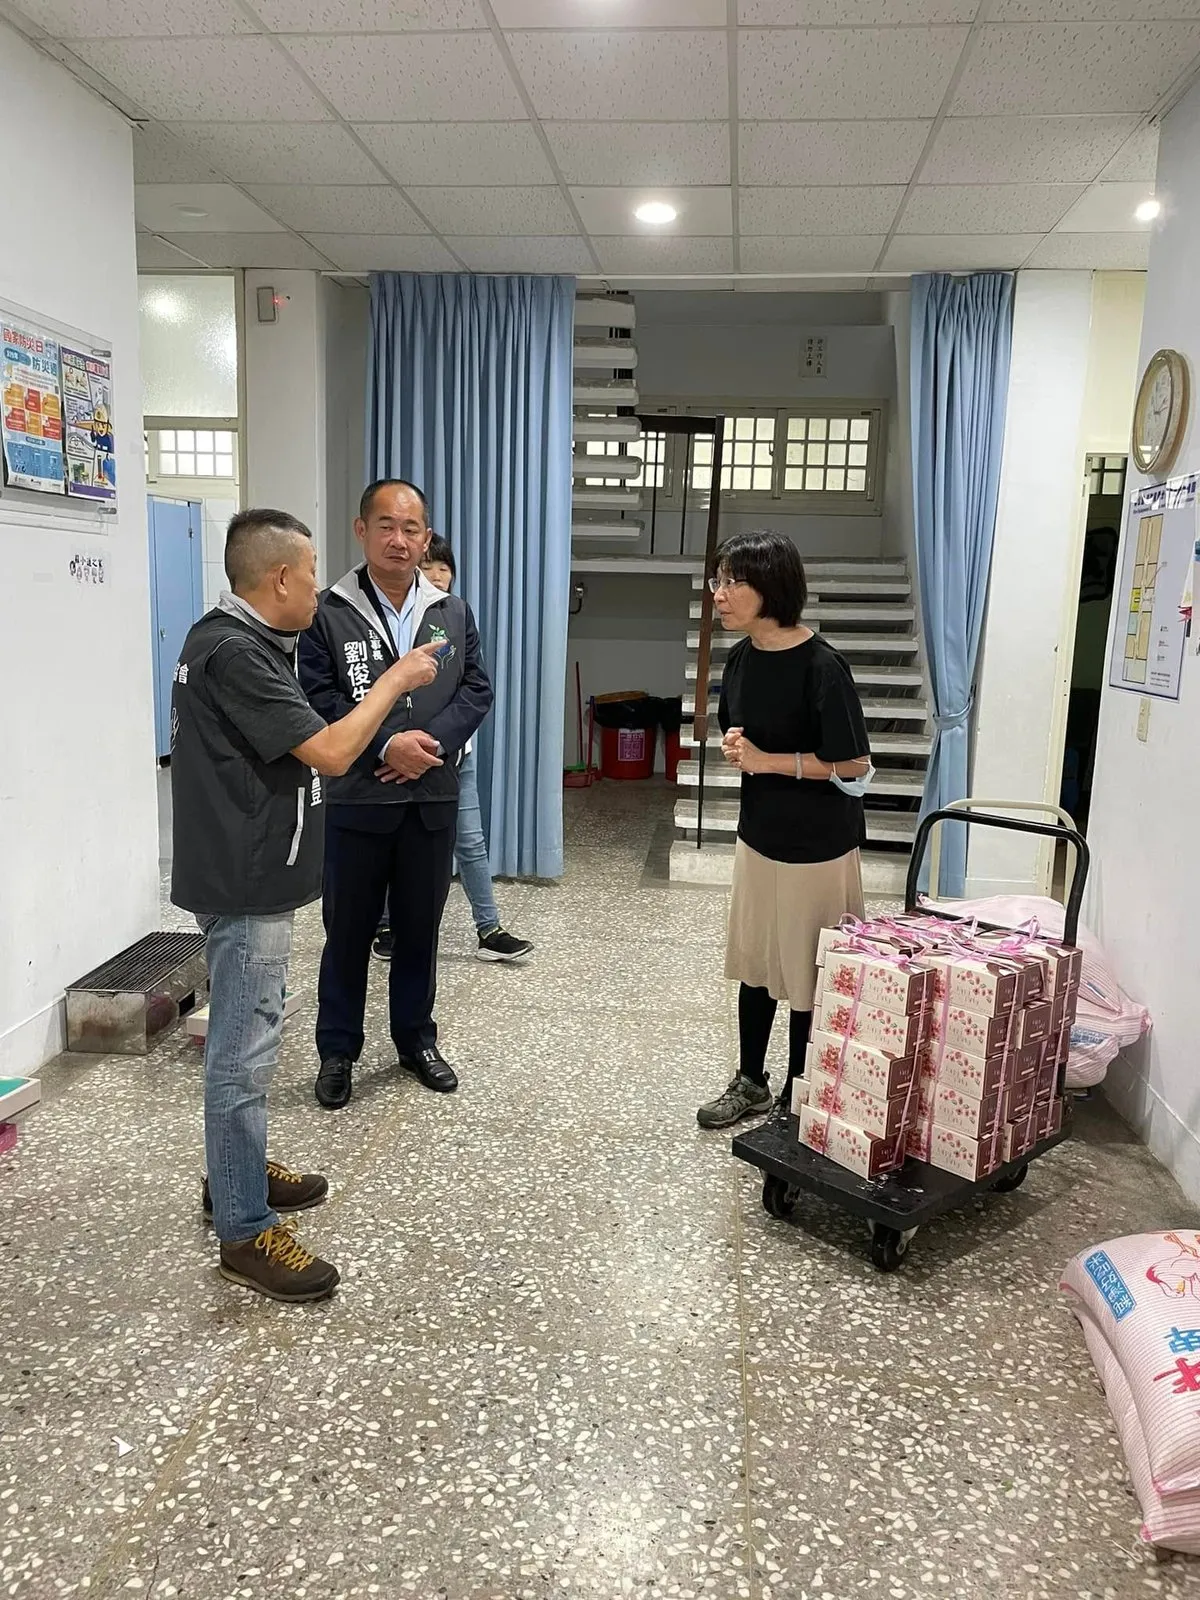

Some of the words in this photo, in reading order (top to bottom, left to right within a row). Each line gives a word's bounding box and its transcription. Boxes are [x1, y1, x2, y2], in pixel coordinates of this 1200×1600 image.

[3, 327, 44, 353] 國家防災日
[368, 629, 384, 661] 理事長
